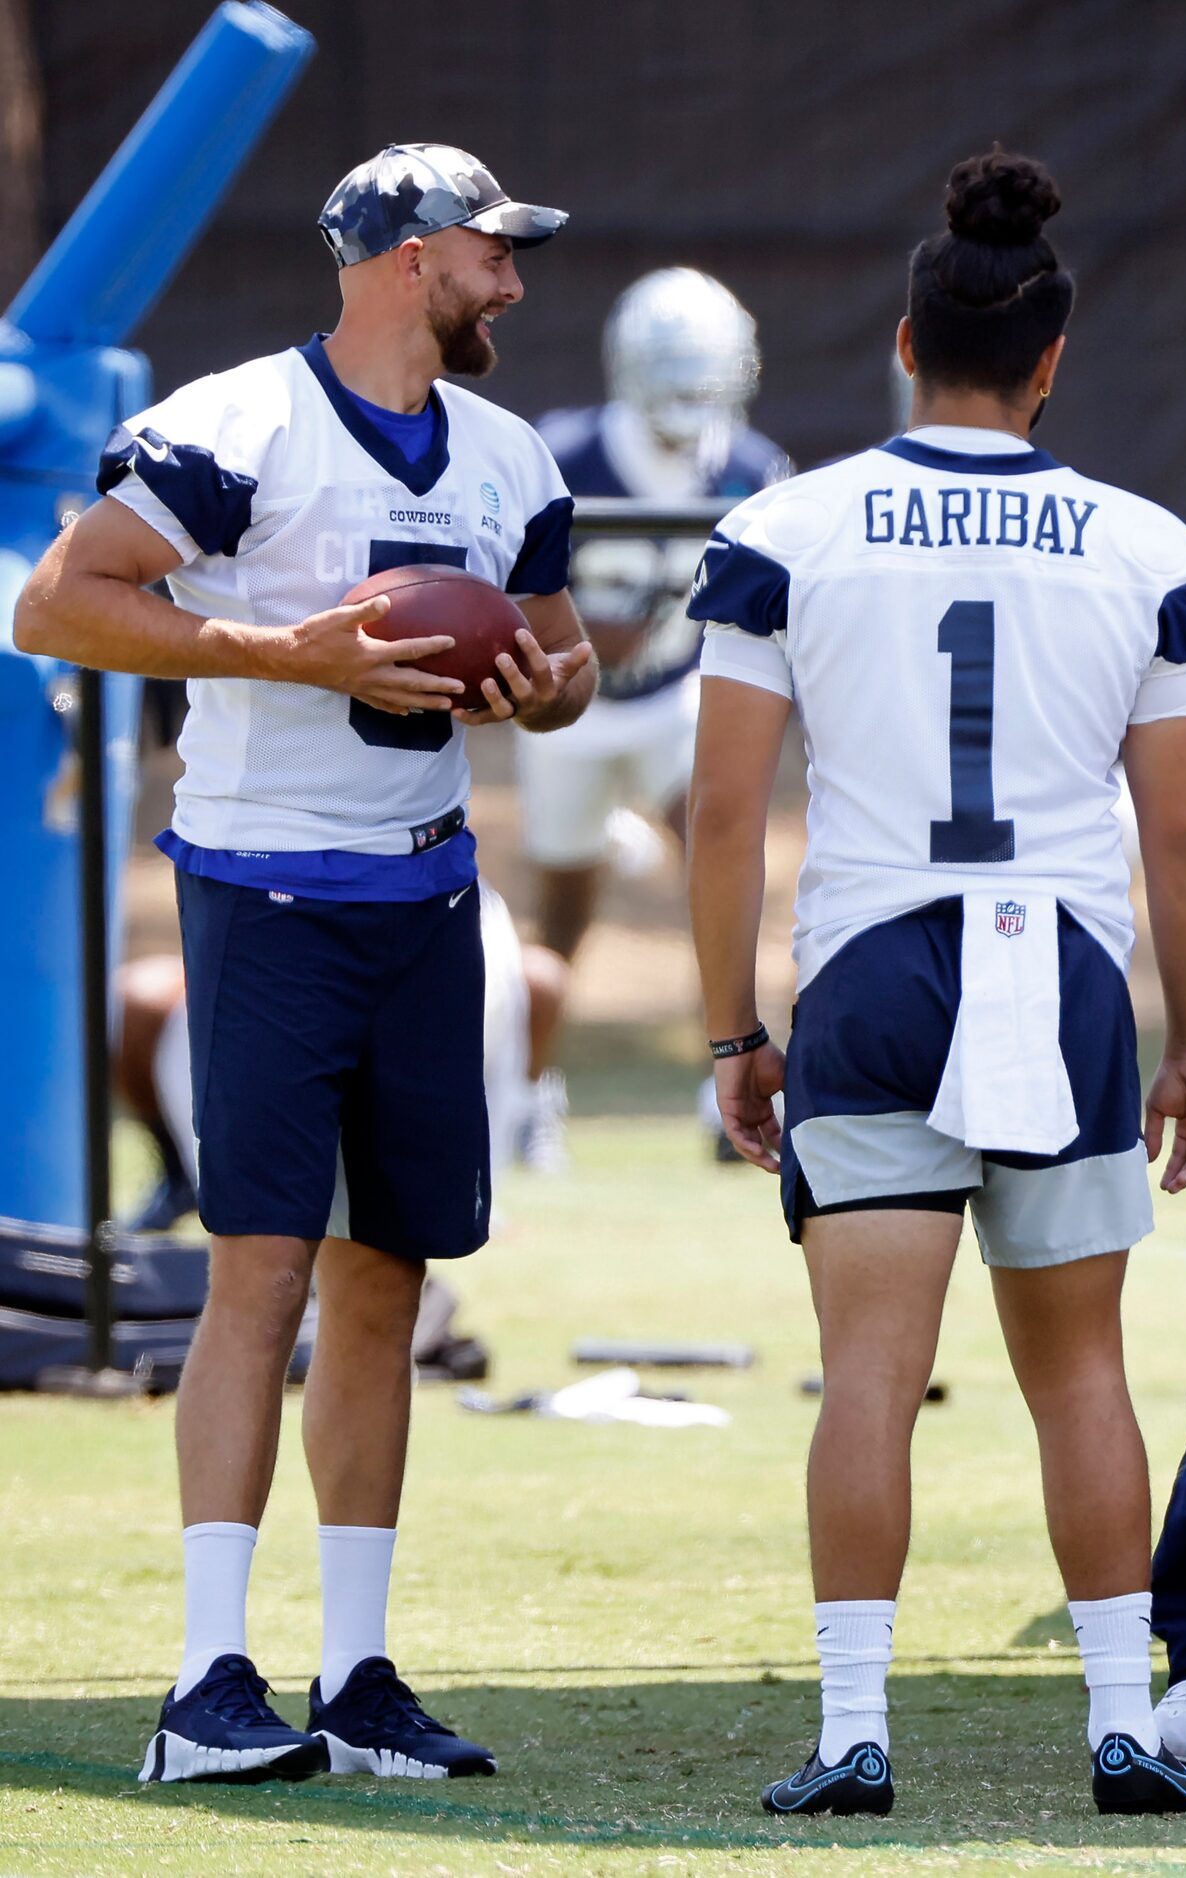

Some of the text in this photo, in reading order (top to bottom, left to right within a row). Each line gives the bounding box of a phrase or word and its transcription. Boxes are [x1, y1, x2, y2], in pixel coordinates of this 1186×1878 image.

[389, 510, 451, 526] COWBOYS
[865, 487, 1098, 556] GARIBAY
[930, 600, 1014, 863] 1
[997, 914, 1025, 933] NFL
